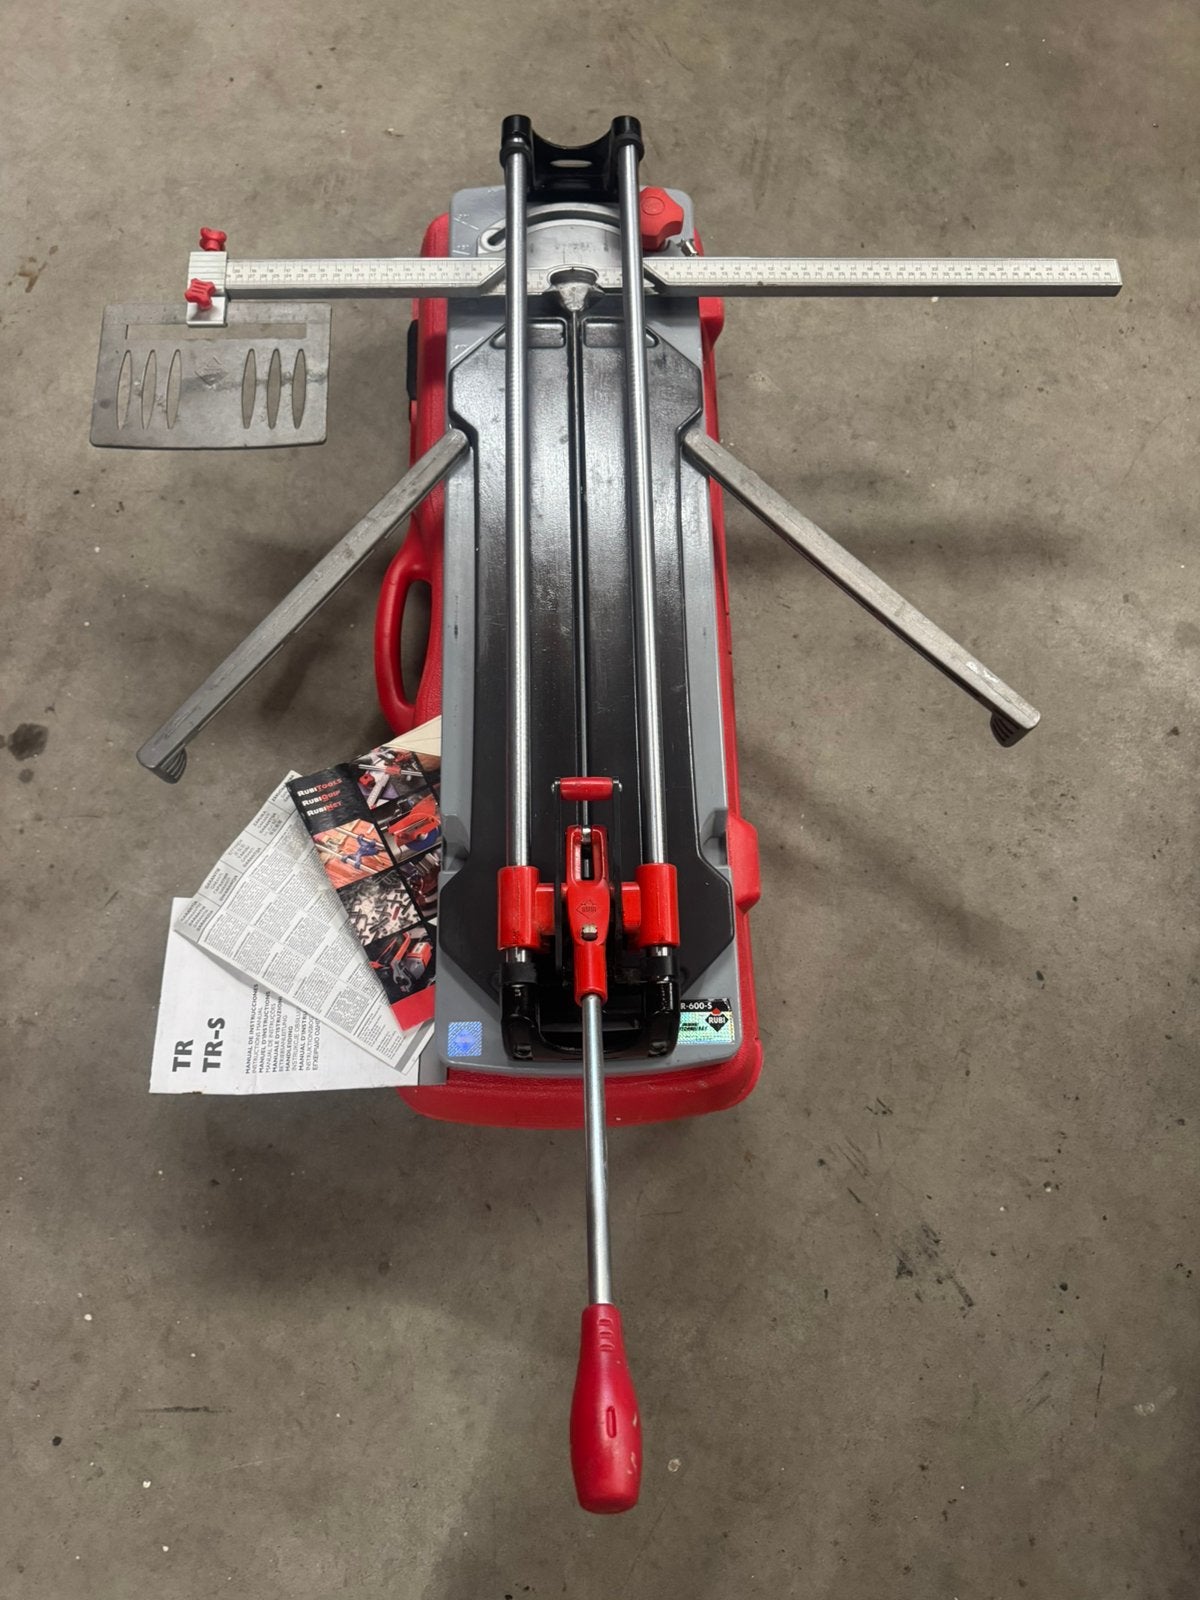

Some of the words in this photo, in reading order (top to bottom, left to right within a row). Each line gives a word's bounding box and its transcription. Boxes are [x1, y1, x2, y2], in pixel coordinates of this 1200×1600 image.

[249, 984, 259, 1035] INSTRUCCIONES
[261, 991, 271, 1045] D'INSTRUCTIONS
[268, 1003, 276, 1038] INSTRUÇÕES
[680, 1001, 713, 1010] R-600-S
[708, 1016, 726, 1024] RUBI
[248, 1036, 254, 1045] DE
[267, 1038, 273, 1047] DE
[300, 1011, 308, 1041] D'INSTRU
[172, 1039, 194, 1072] TR
[202, 1017, 226, 1073] TR-S
[245, 1045, 253, 1074] MANUAL
[252, 1032, 260, 1074] INSTRUCTIONS
[259, 1045, 267, 1073] MANUEL
[272, 1040, 280, 1073] MANUALE
[279, 1015, 288, 1072] BETRIEBSANLEITUNG
[285, 1025, 294, 1072] HANDLEIDING
[292, 1034, 300, 1071] INSTRUKCJE
[298, 1042, 306, 1071] MANUAL
[265, 1048, 273, 1073] MANUAL
